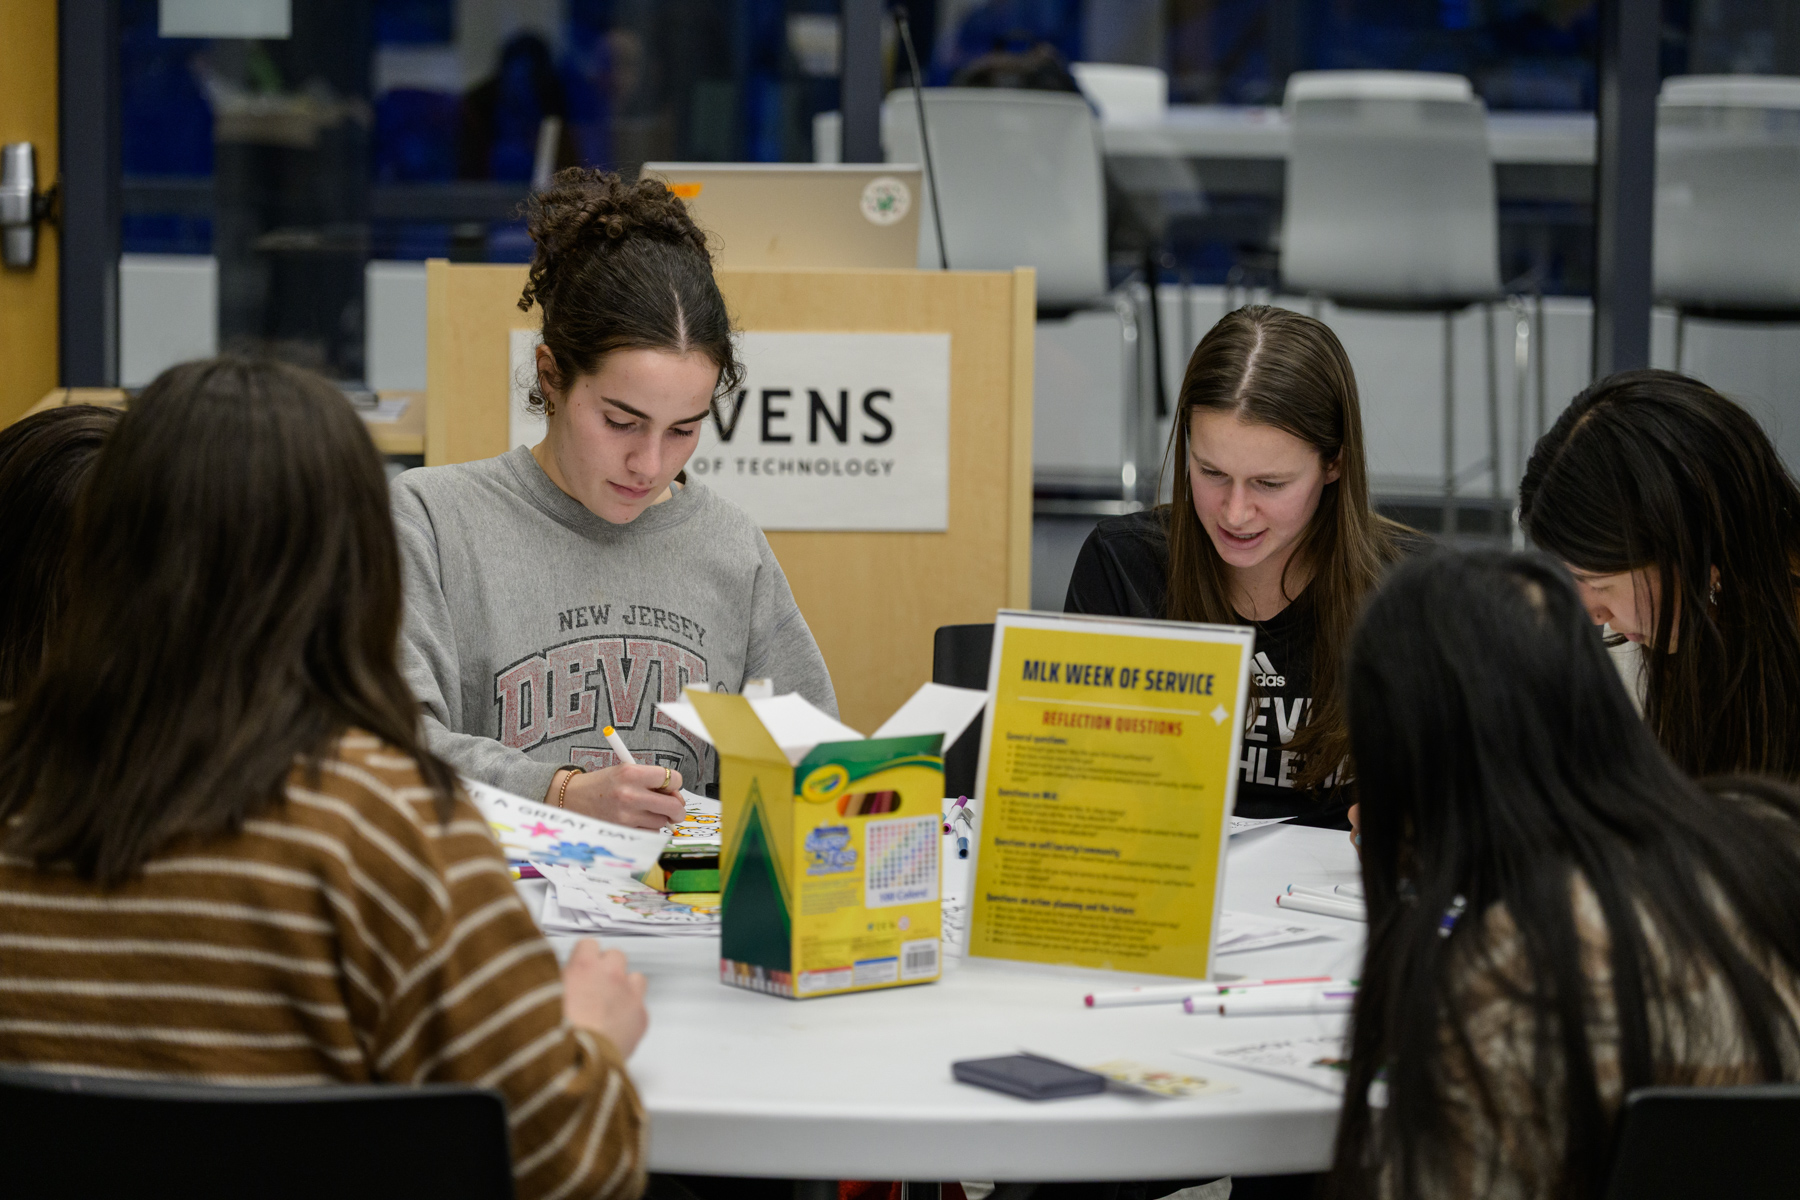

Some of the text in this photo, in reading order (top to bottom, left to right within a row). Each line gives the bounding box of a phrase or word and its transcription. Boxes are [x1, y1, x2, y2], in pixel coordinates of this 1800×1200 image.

[711, 388, 894, 444] VENS
[692, 456, 895, 477] OF TECHNOLOGY
[558, 604, 706, 647] NEW JERSEY
[1022, 660, 1214, 695] MLK WEEK OF SERVICE
[1253, 673, 1286, 687] das
[1042, 711, 1183, 736] REFLECTION QUESTIONS
[494, 798, 642, 842] A GREAT DAY
